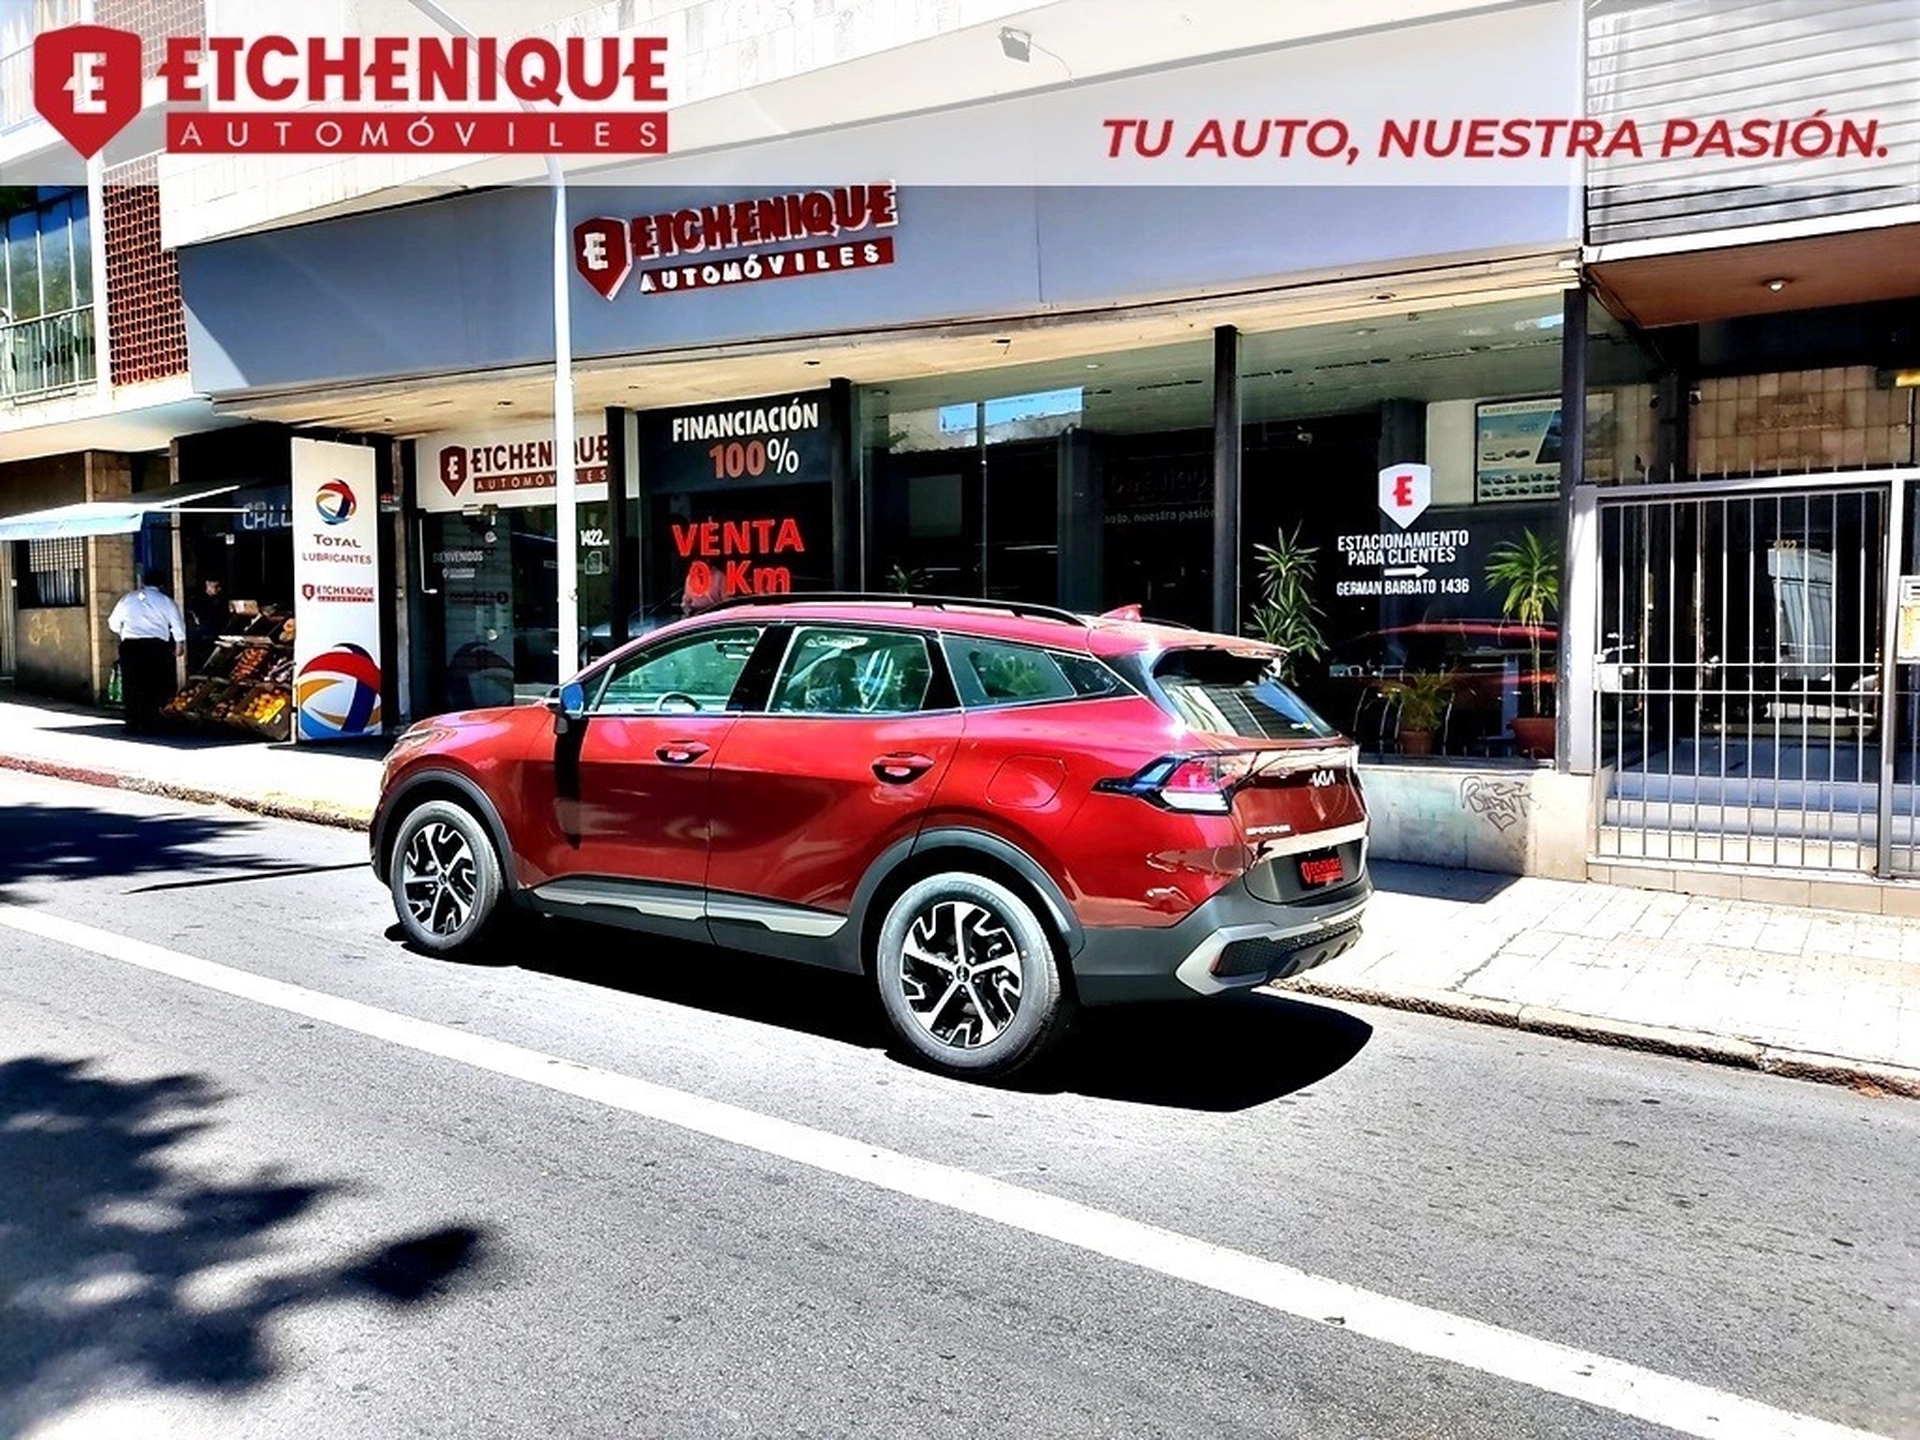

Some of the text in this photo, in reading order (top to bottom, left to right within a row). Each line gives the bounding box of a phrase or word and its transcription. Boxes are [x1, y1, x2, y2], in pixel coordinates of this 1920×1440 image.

[629, 181, 897, 260] ETCHENIQUE
[639, 242, 880, 292] AUTOMÓVILES
[672, 397, 819, 442] FINANCIACIÓN
[471, 434, 608, 473] ETCHENUE
[709, 437, 800, 479] 100%
[1134, 510, 1177, 522] nuestra
[671, 518, 805, 558] VENTA
[1337, 529, 1470, 552] ESTACIONAMIENTO
[1347, 546, 1457, 566] PARA CLIENTES
[302, 552, 372, 565] LUBRICANTES
[726, 560, 791, 596] Km
[1336, 578, 1470, 596] GERMAN BARBATO 1436
